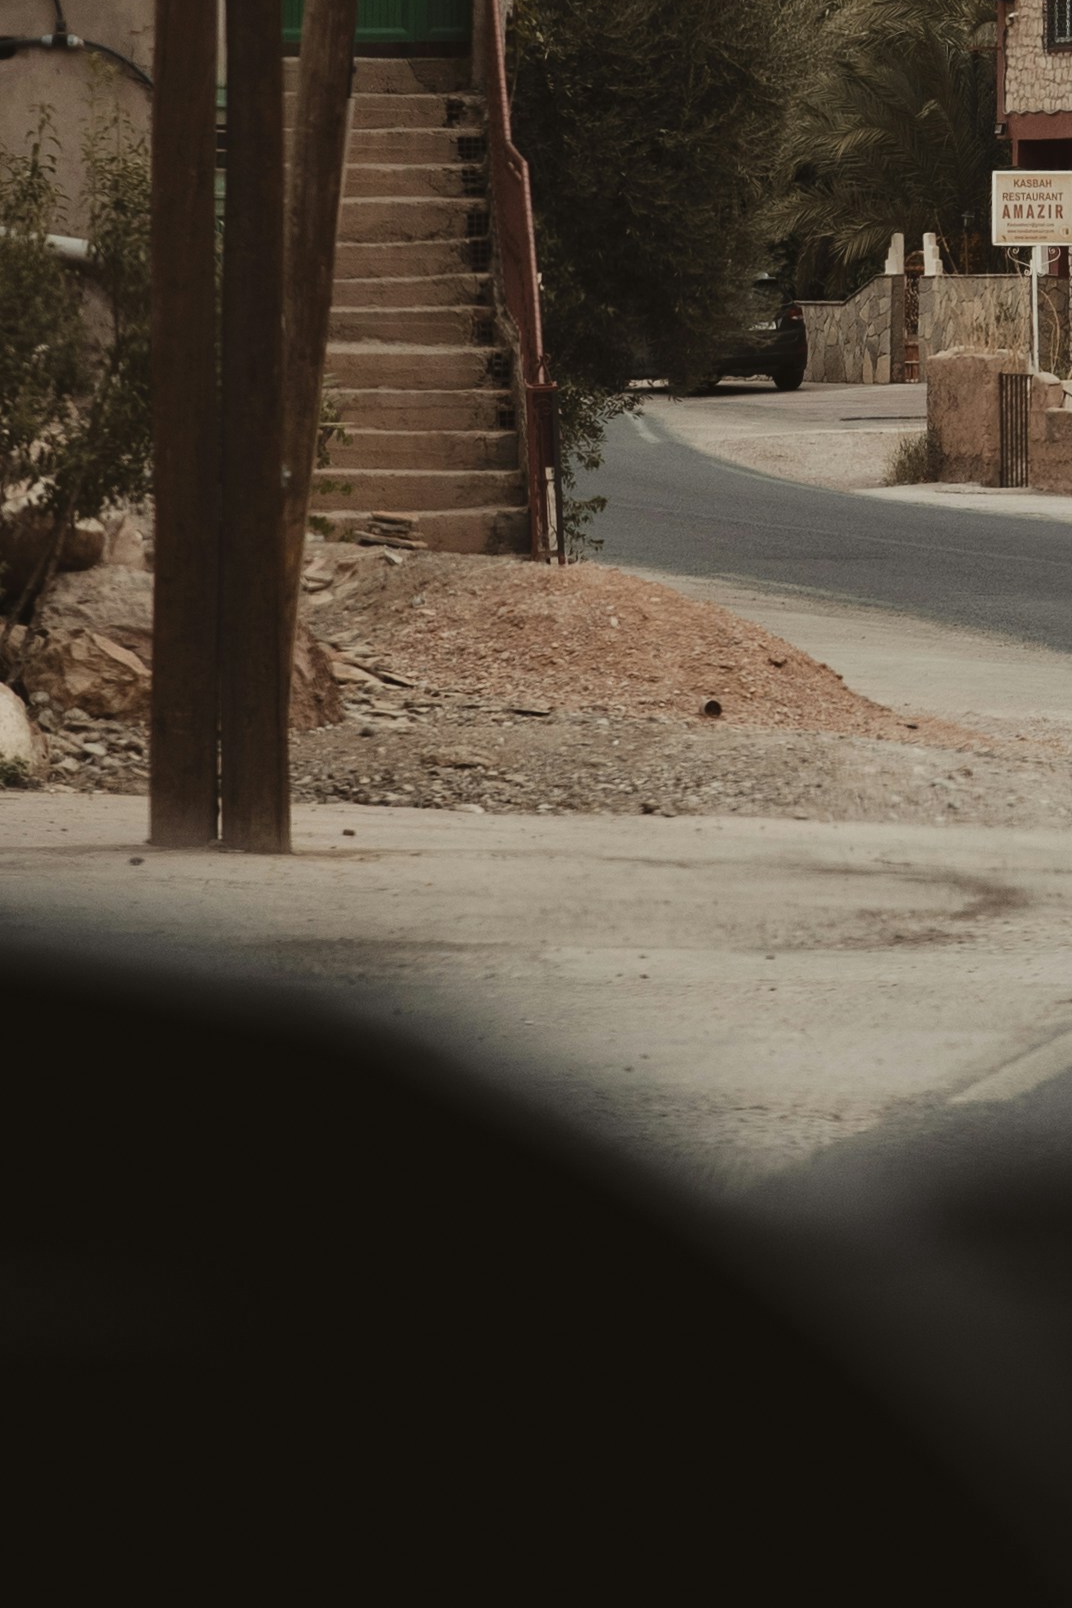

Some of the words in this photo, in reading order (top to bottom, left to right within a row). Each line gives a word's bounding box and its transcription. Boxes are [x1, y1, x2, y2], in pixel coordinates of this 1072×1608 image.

[1013, 179, 1052, 188] KASBAH
[1002, 192, 1063, 202] RESTAURANT
[1002, 204, 1064, 220] AMAZIR
